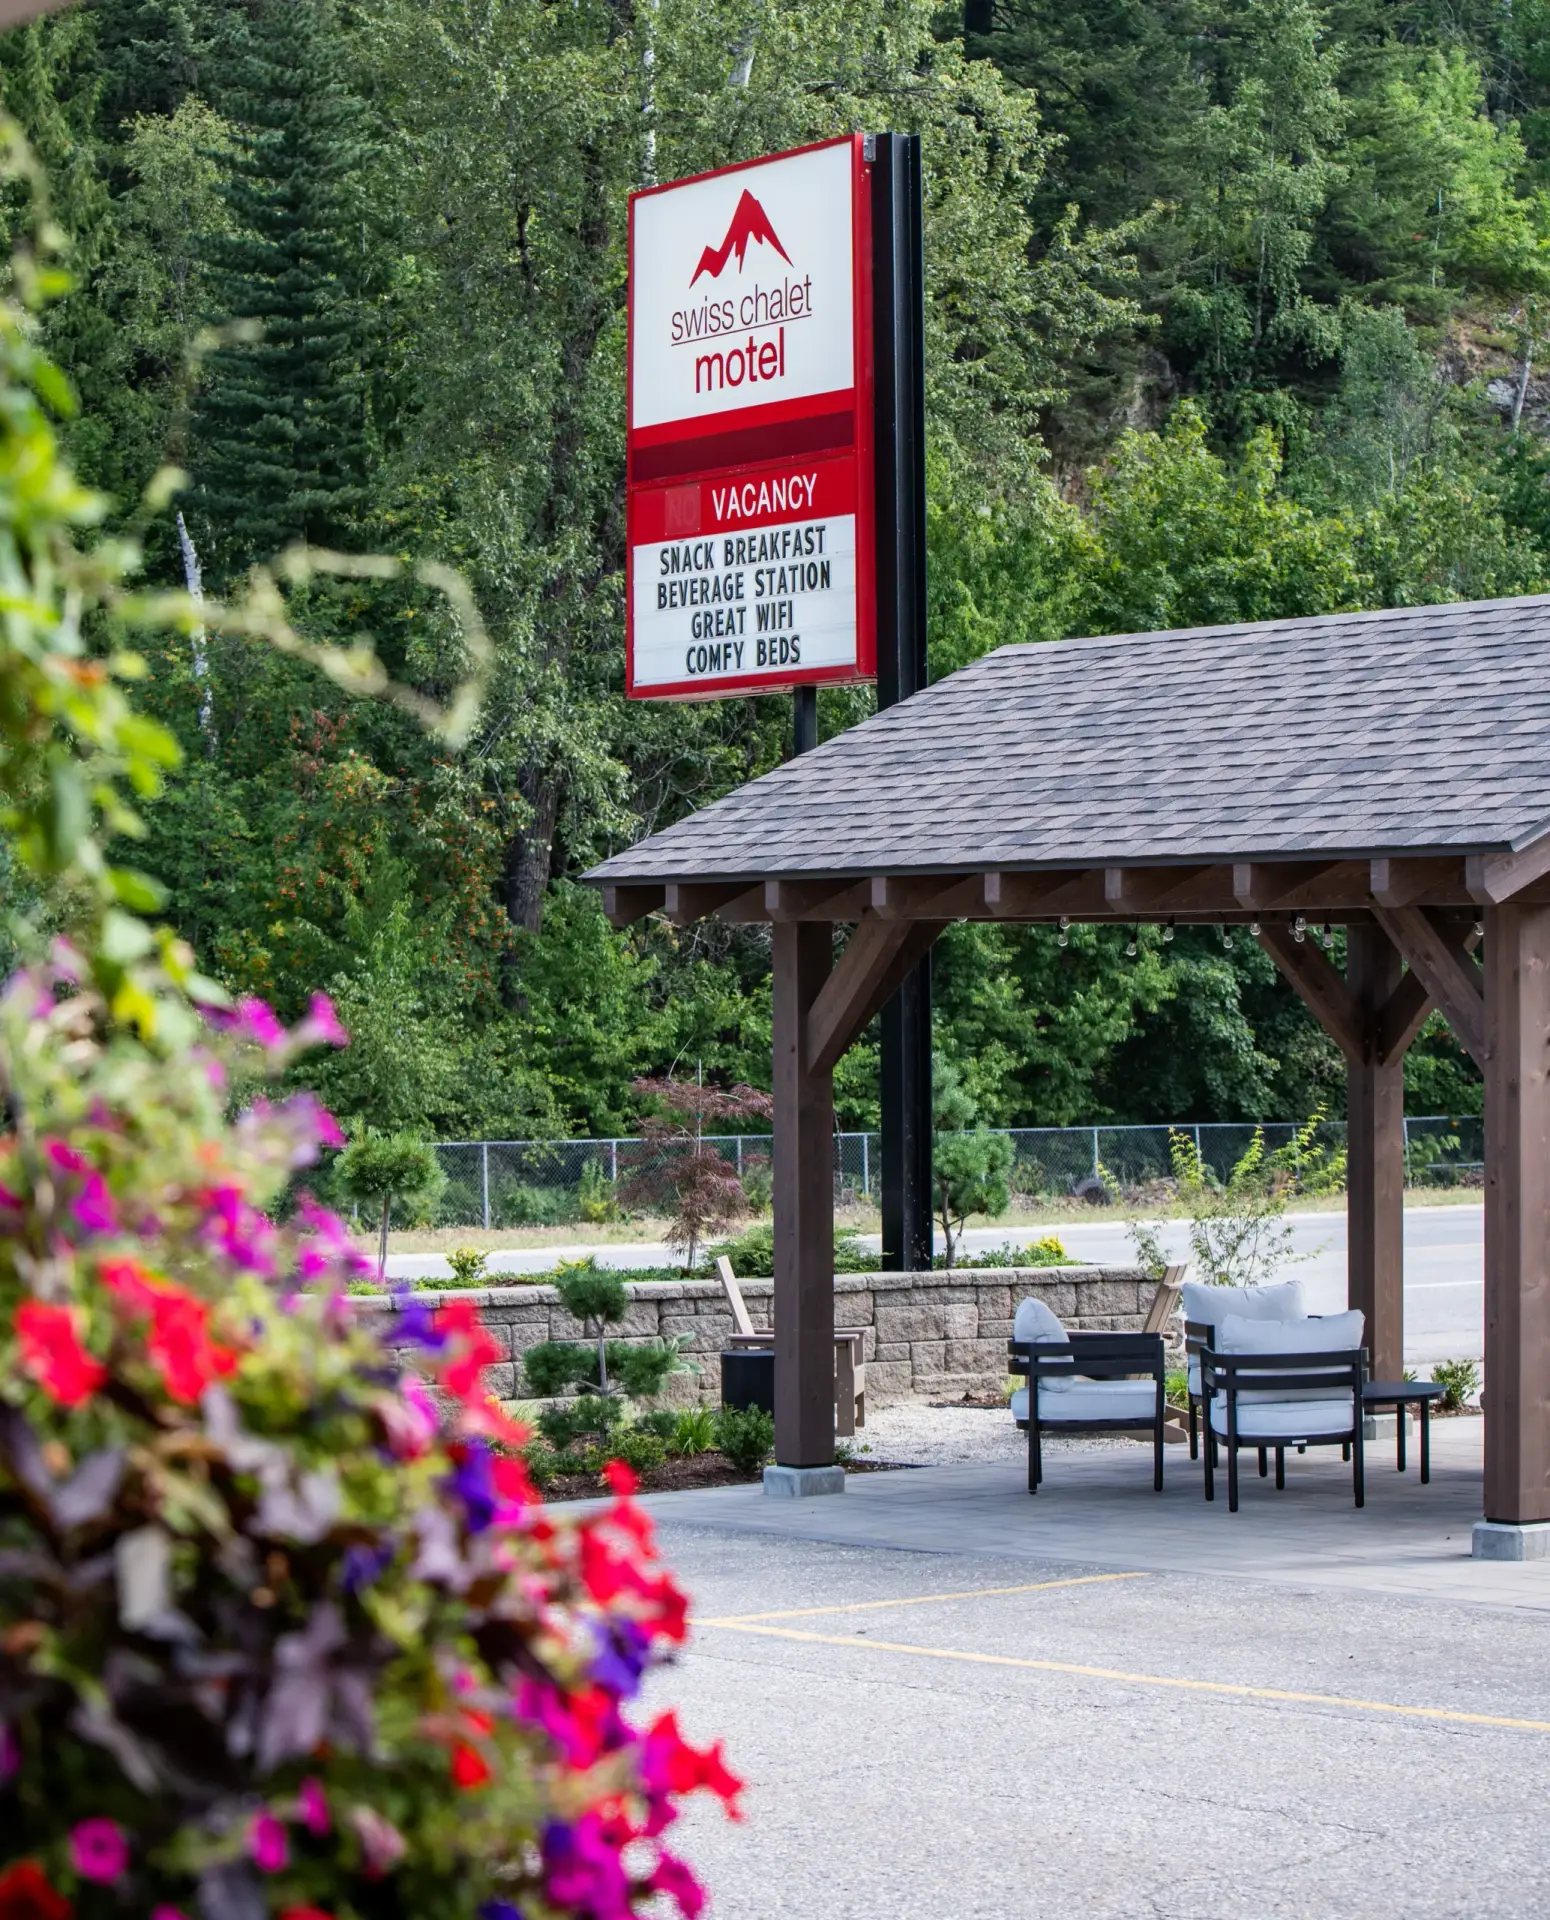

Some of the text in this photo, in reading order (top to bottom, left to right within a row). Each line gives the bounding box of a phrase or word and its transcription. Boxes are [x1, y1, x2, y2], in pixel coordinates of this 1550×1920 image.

[671, 274, 812, 341] swiss chalet
[696, 327, 784, 393] motel
[712, 473, 818, 521] VACANCY
[660, 525, 826, 576] SNACK BREAKFAST
[657, 560, 830, 609] BEVERAGE STATION
[691, 600, 793, 639] GREAT WIFI
[686, 635, 800, 674] COMFY BEDS
